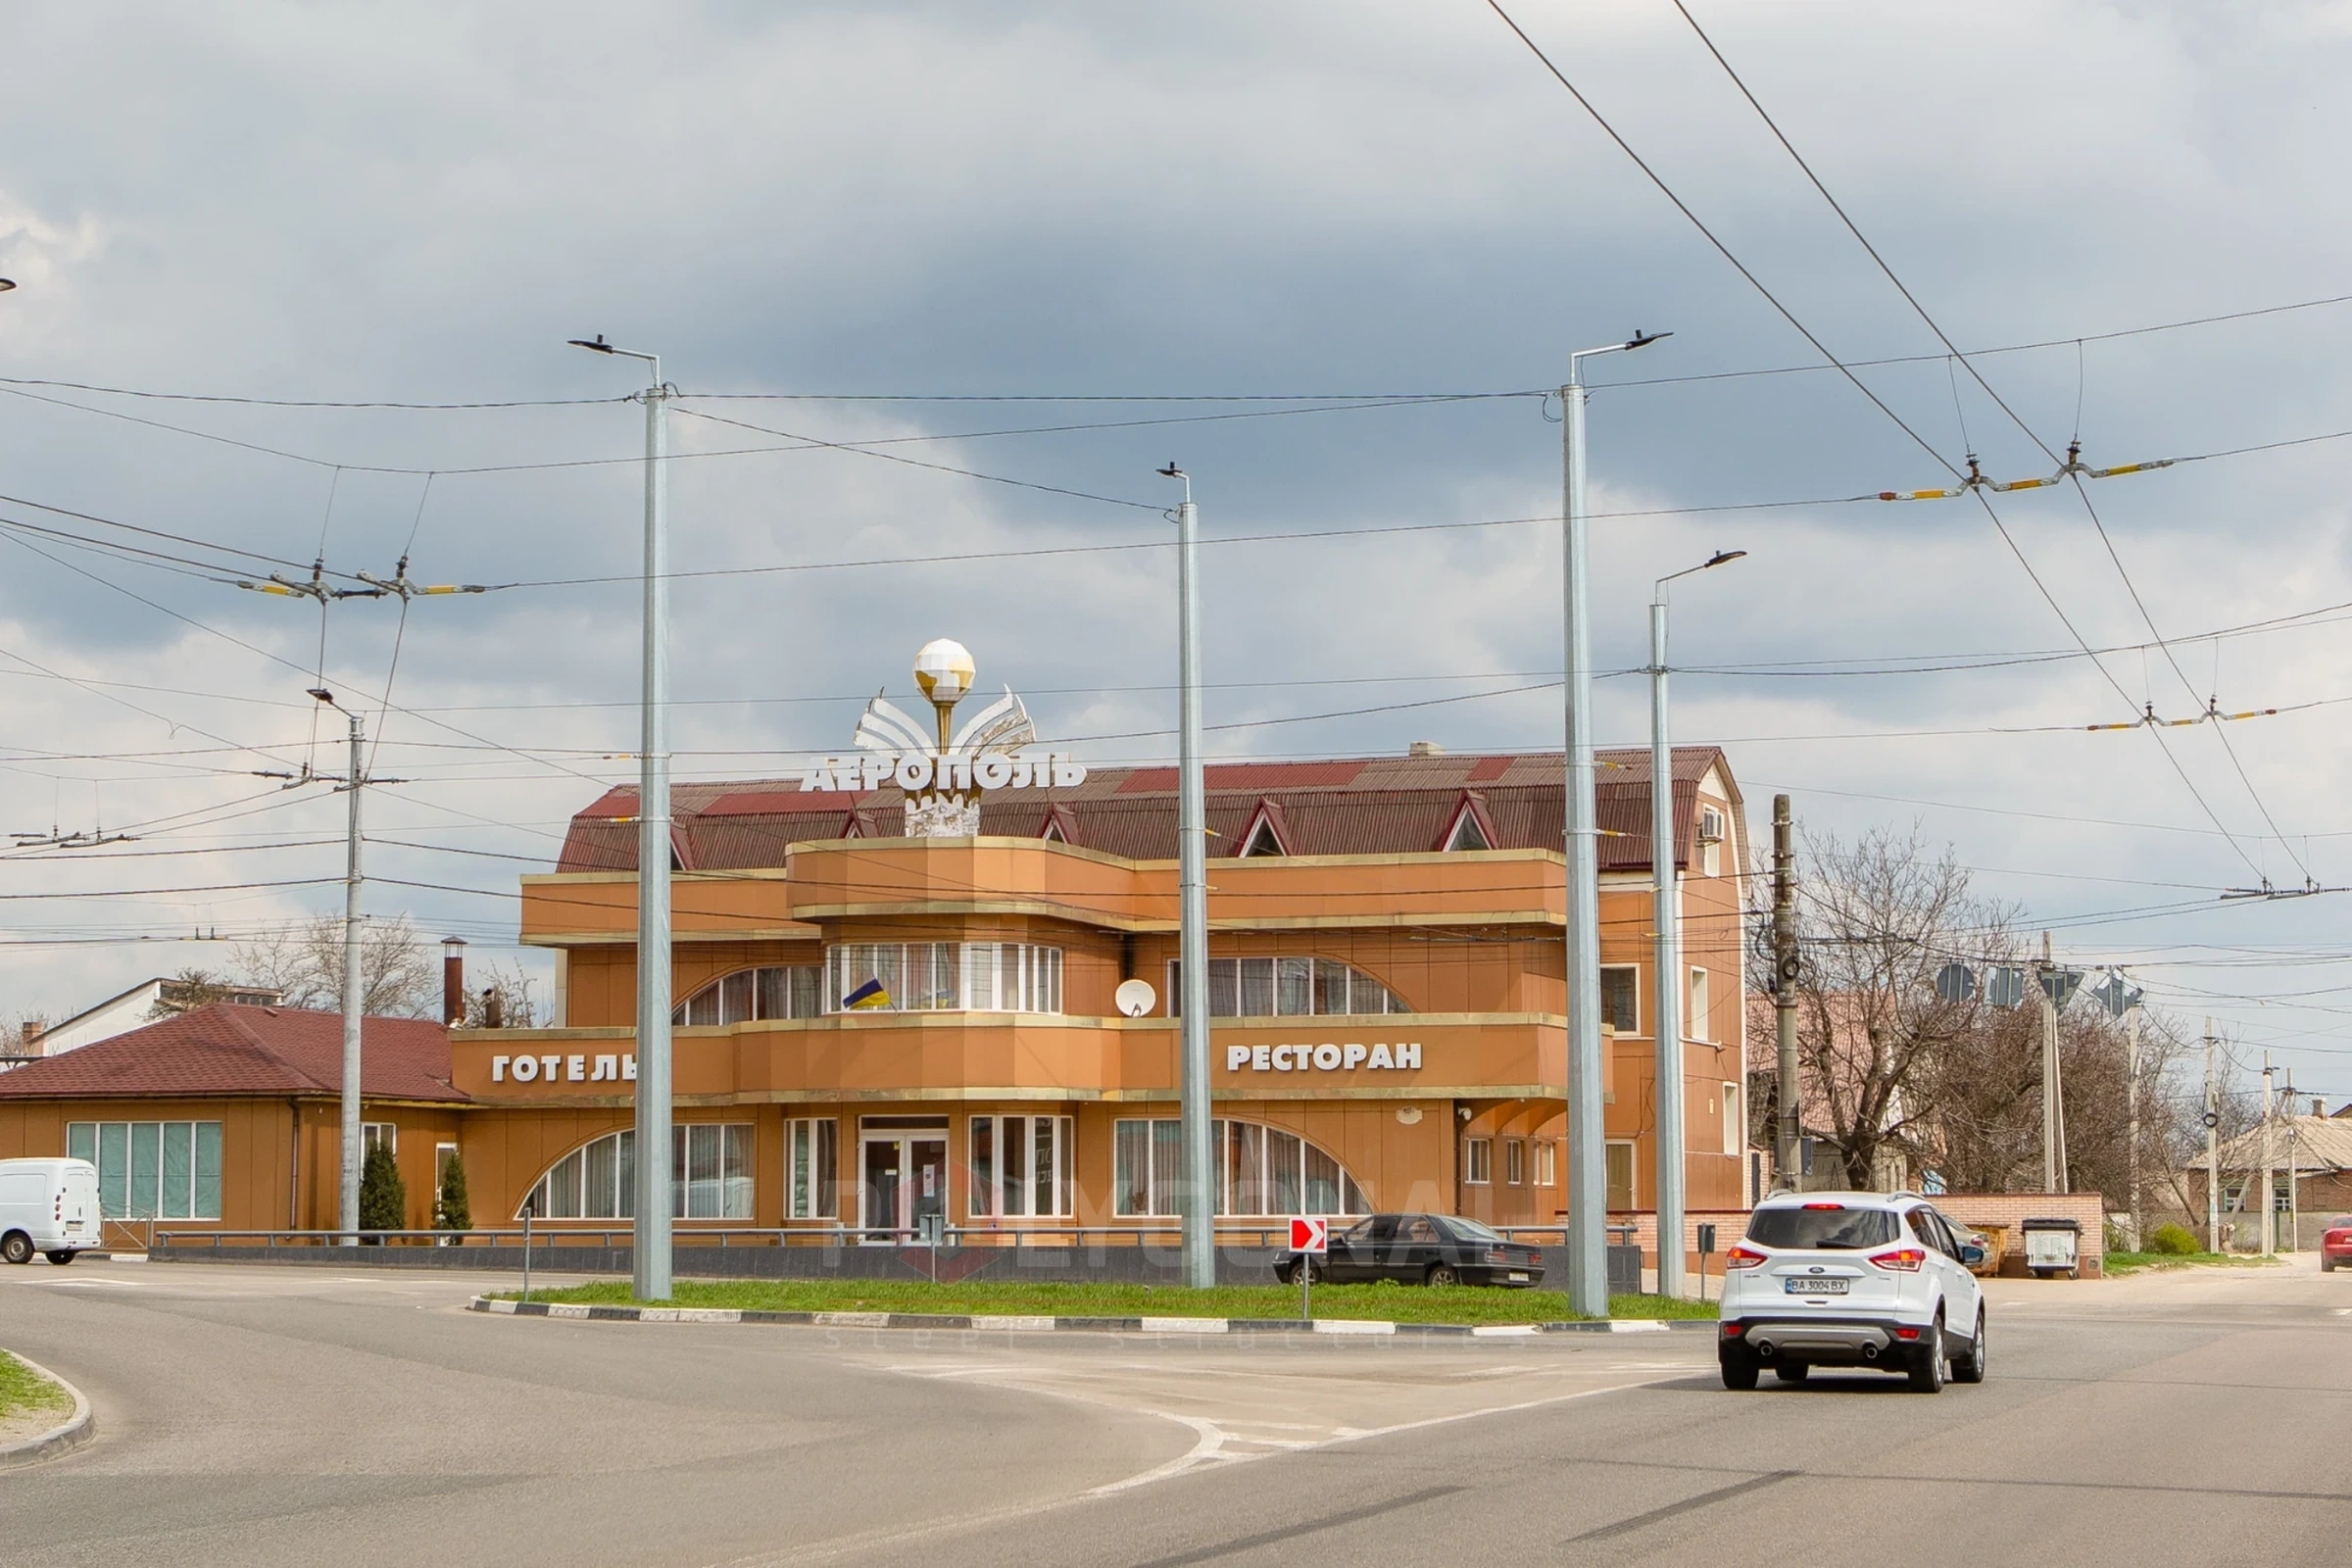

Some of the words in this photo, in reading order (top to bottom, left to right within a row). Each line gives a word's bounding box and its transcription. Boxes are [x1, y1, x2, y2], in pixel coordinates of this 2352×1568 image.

[799, 752, 1088, 792] АЕРОПОЛЬ
[492, 1054, 637, 1082] ГОТЕЛЬ
[1227, 1043, 1422, 1071] РЕСТОРАН
